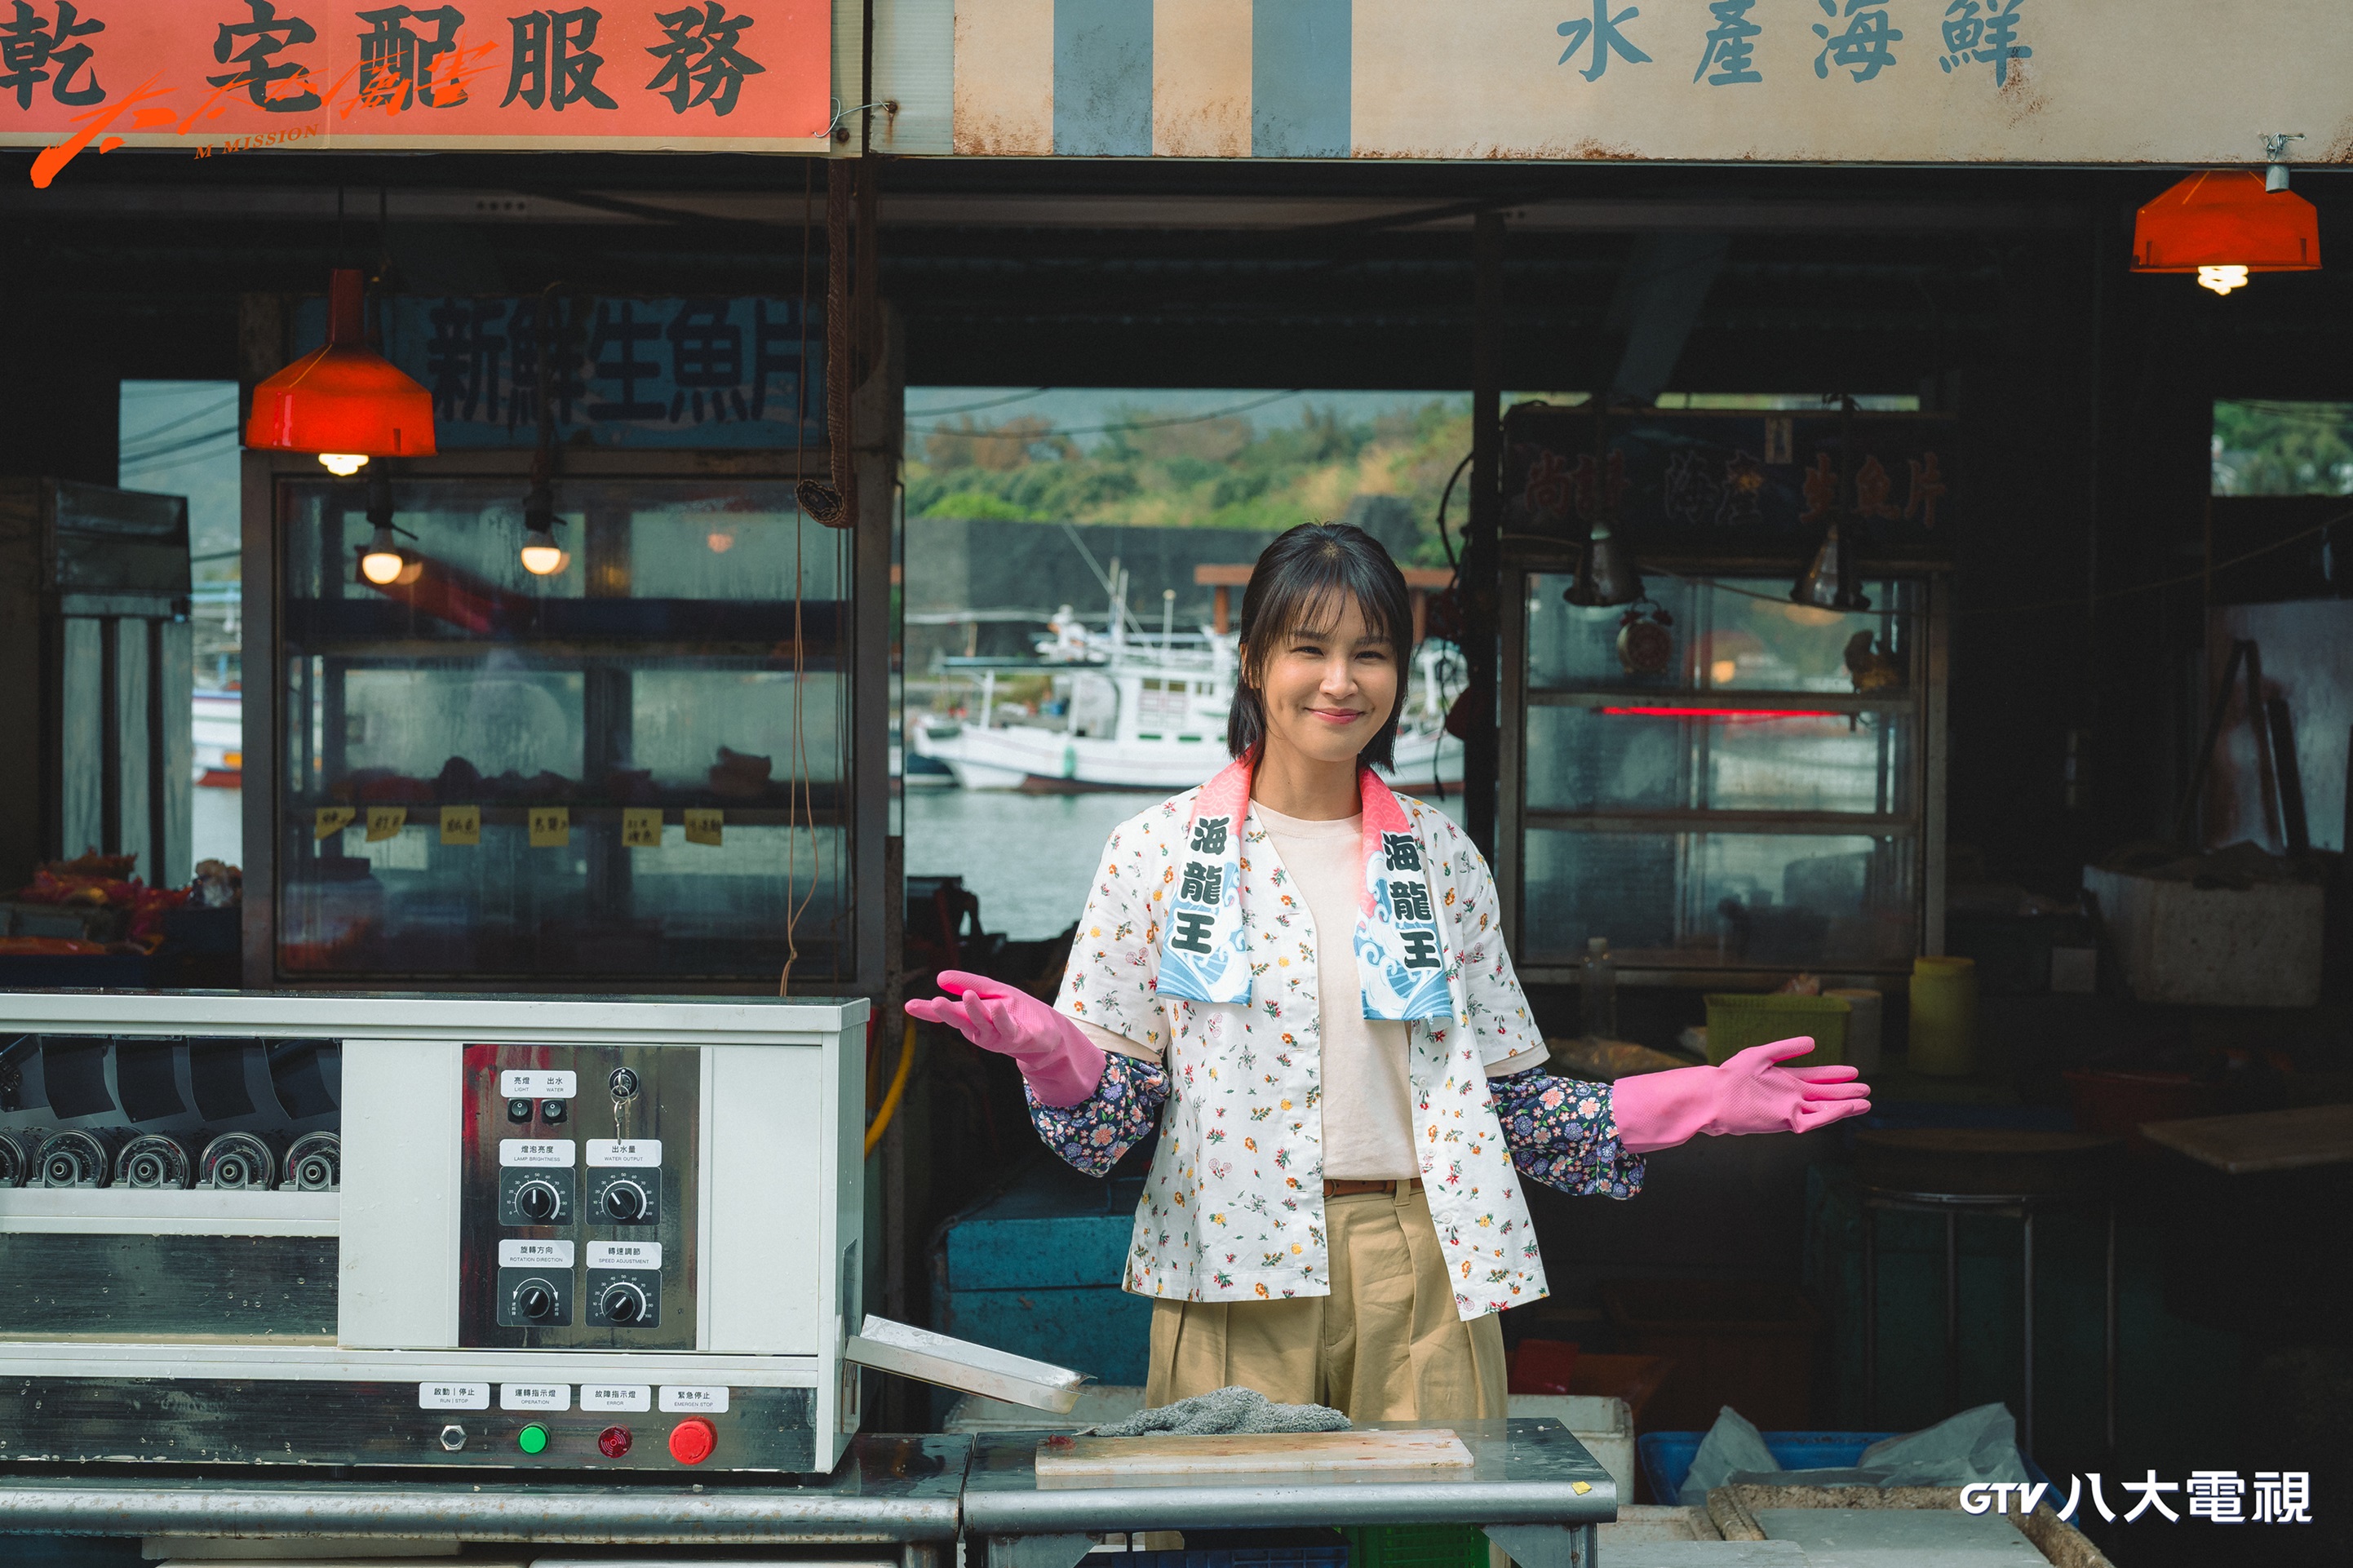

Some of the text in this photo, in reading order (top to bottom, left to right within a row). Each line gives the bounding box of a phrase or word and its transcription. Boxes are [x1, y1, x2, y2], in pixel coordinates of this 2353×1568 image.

[1556, 0, 2032, 87] 水產海鮮
[0, 0, 767, 117] 乾 宅配服務
[427, 296, 821, 423] 新鮮生魚片
[1171, 817, 1230, 955] 海龍王
[1382, 832, 1442, 970] 海龍王
[514, 1076, 563, 1085] 亮燈 出水
[521, 1145, 554, 1154] 燈泡亮度
[611, 1145, 636, 1154] 出水量
[520, 1246, 553, 1255] 旋轉方向
[608, 1247, 640, 1256] 轉速調節
[459, 1388, 475, 1396] 停止
[515, 1389, 556, 1397] 運轉指示燈
[595, 1389, 636, 1398] 故障指示燈
[677, 1391, 711, 1400] 緊急停止
